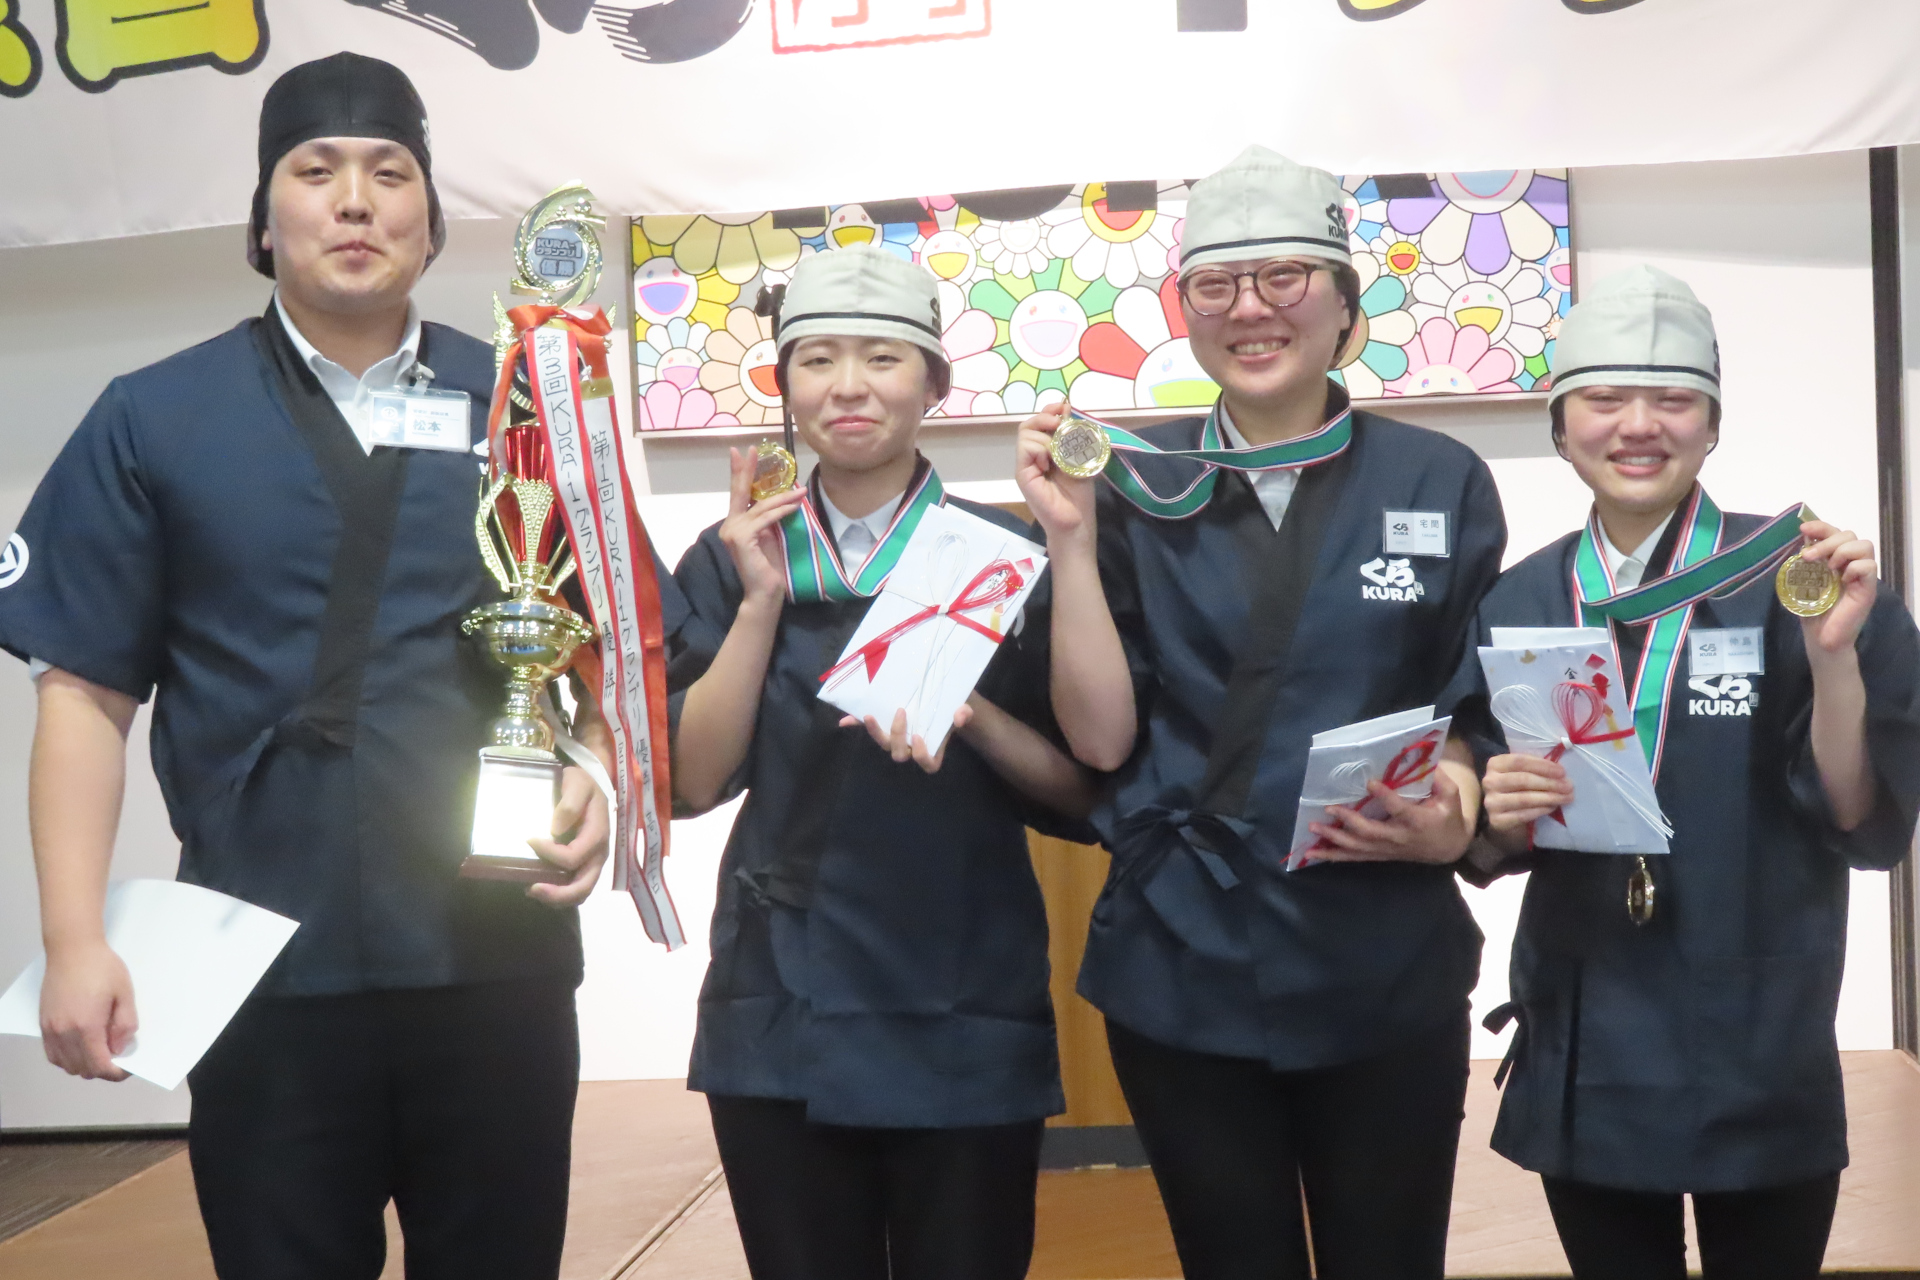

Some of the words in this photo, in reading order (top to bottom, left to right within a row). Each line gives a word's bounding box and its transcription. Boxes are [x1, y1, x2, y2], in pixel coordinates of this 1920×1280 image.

[413, 419, 441, 432] 松本
[1362, 585, 1418, 602] KURA
[1689, 699, 1752, 716] KURA
